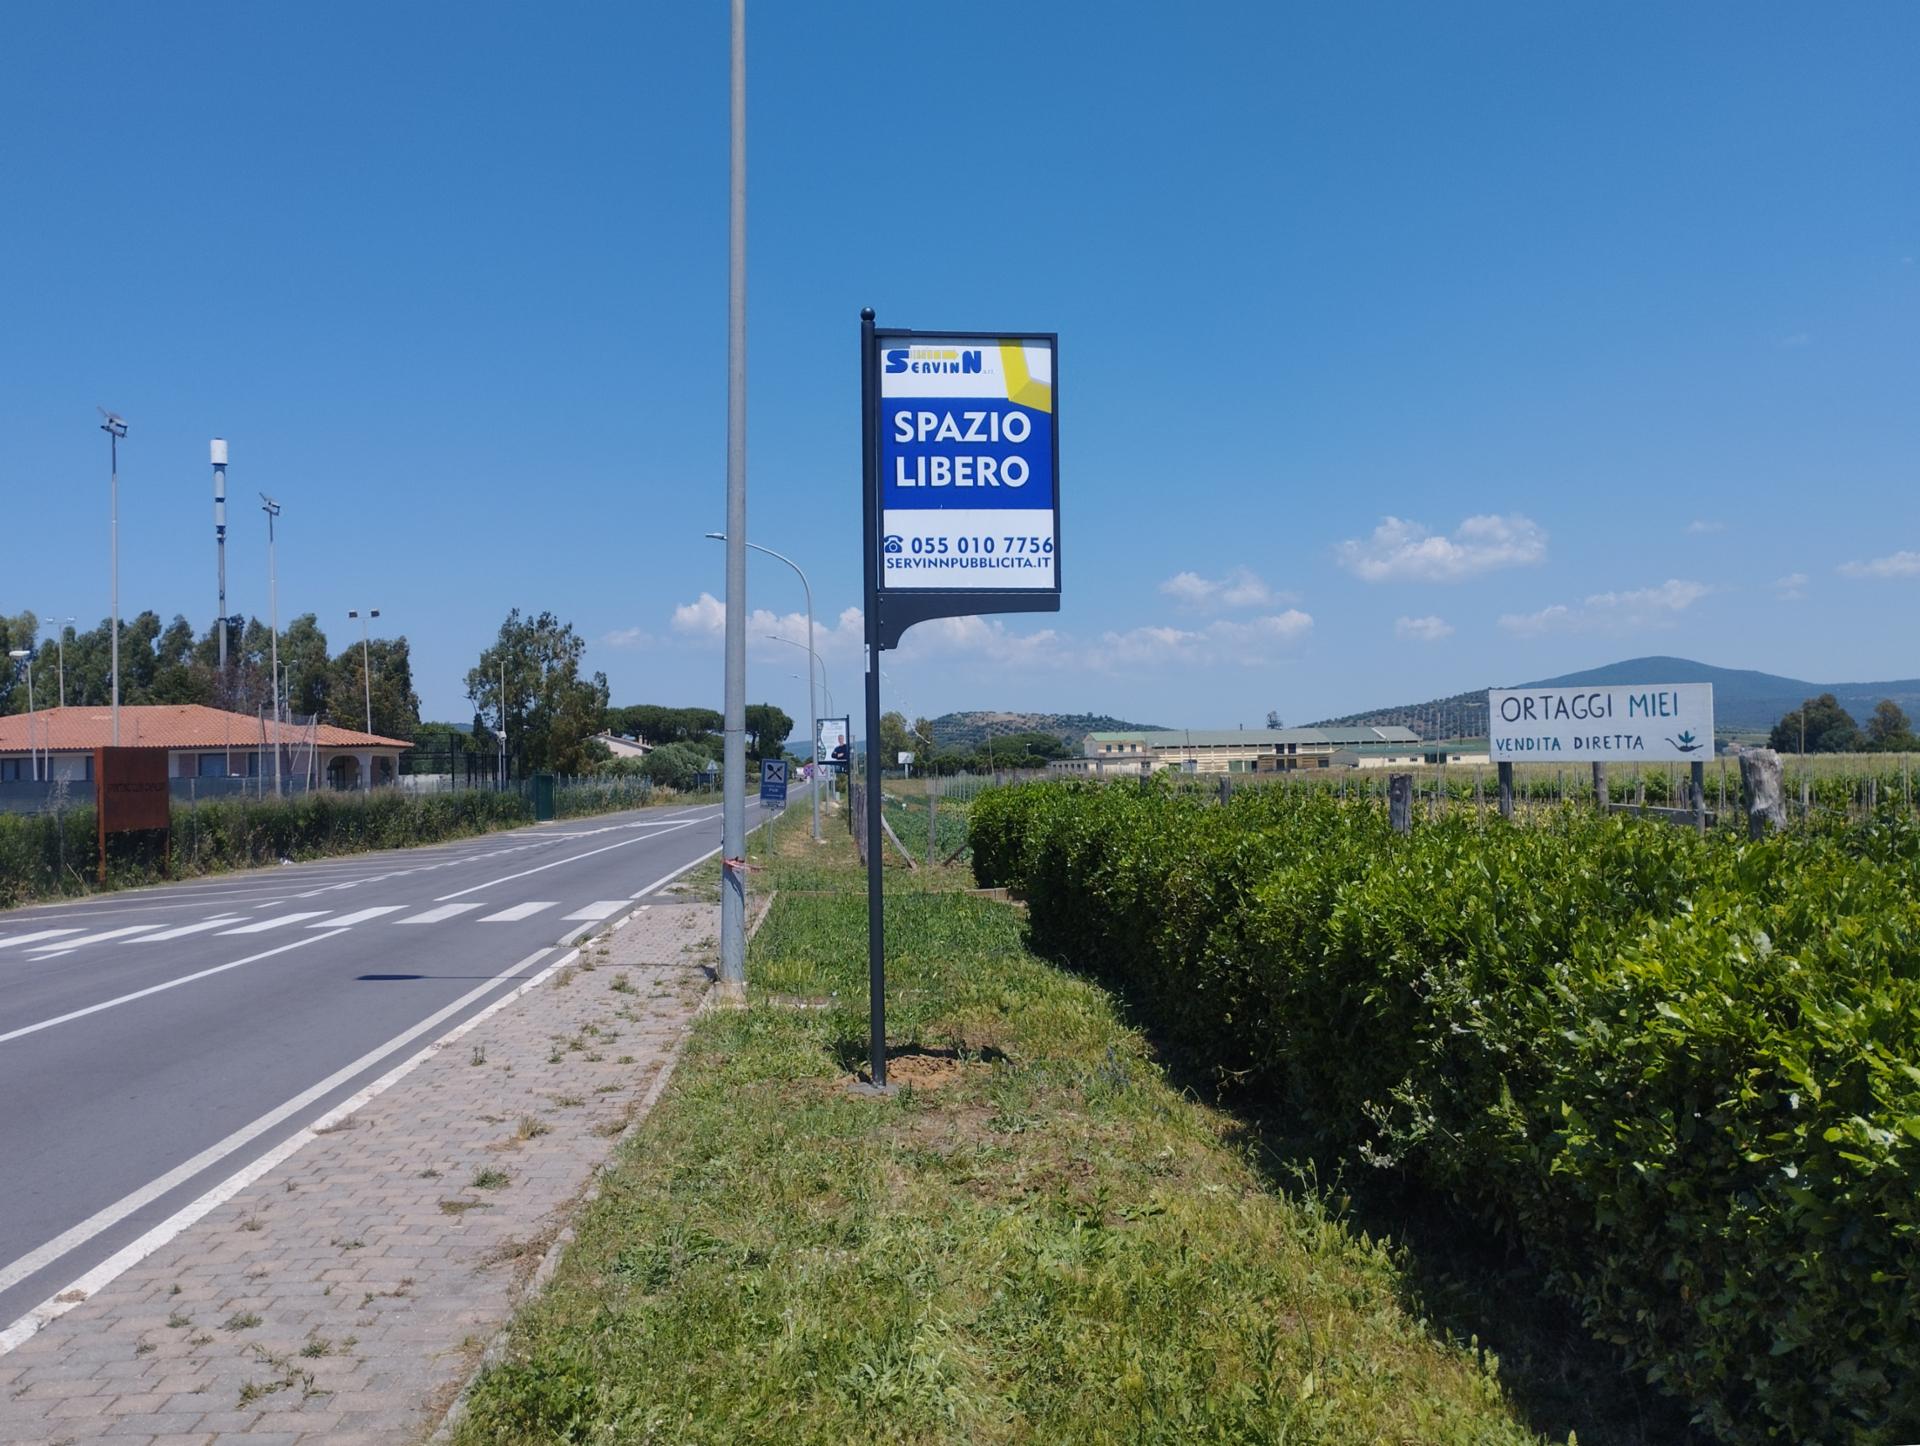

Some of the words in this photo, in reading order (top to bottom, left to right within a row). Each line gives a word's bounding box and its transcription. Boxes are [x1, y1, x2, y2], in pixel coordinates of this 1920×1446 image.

[894, 411, 1031, 443] SPAZIO
[896, 456, 1030, 487] LIBERO
[911, 537, 949, 553] 055
[957, 537, 995, 553] 010
[1003, 537, 1053, 553] 7756
[886, 557, 1051, 569] SERVINNPUBBLICITA.IT
[1501, 694, 1612, 722] ORTAGGI
[1629, 692, 1678, 718] MIEI
[1496, 737, 1561, 752] VENDITA
[1574, 735, 1645, 750] DIRETTA
